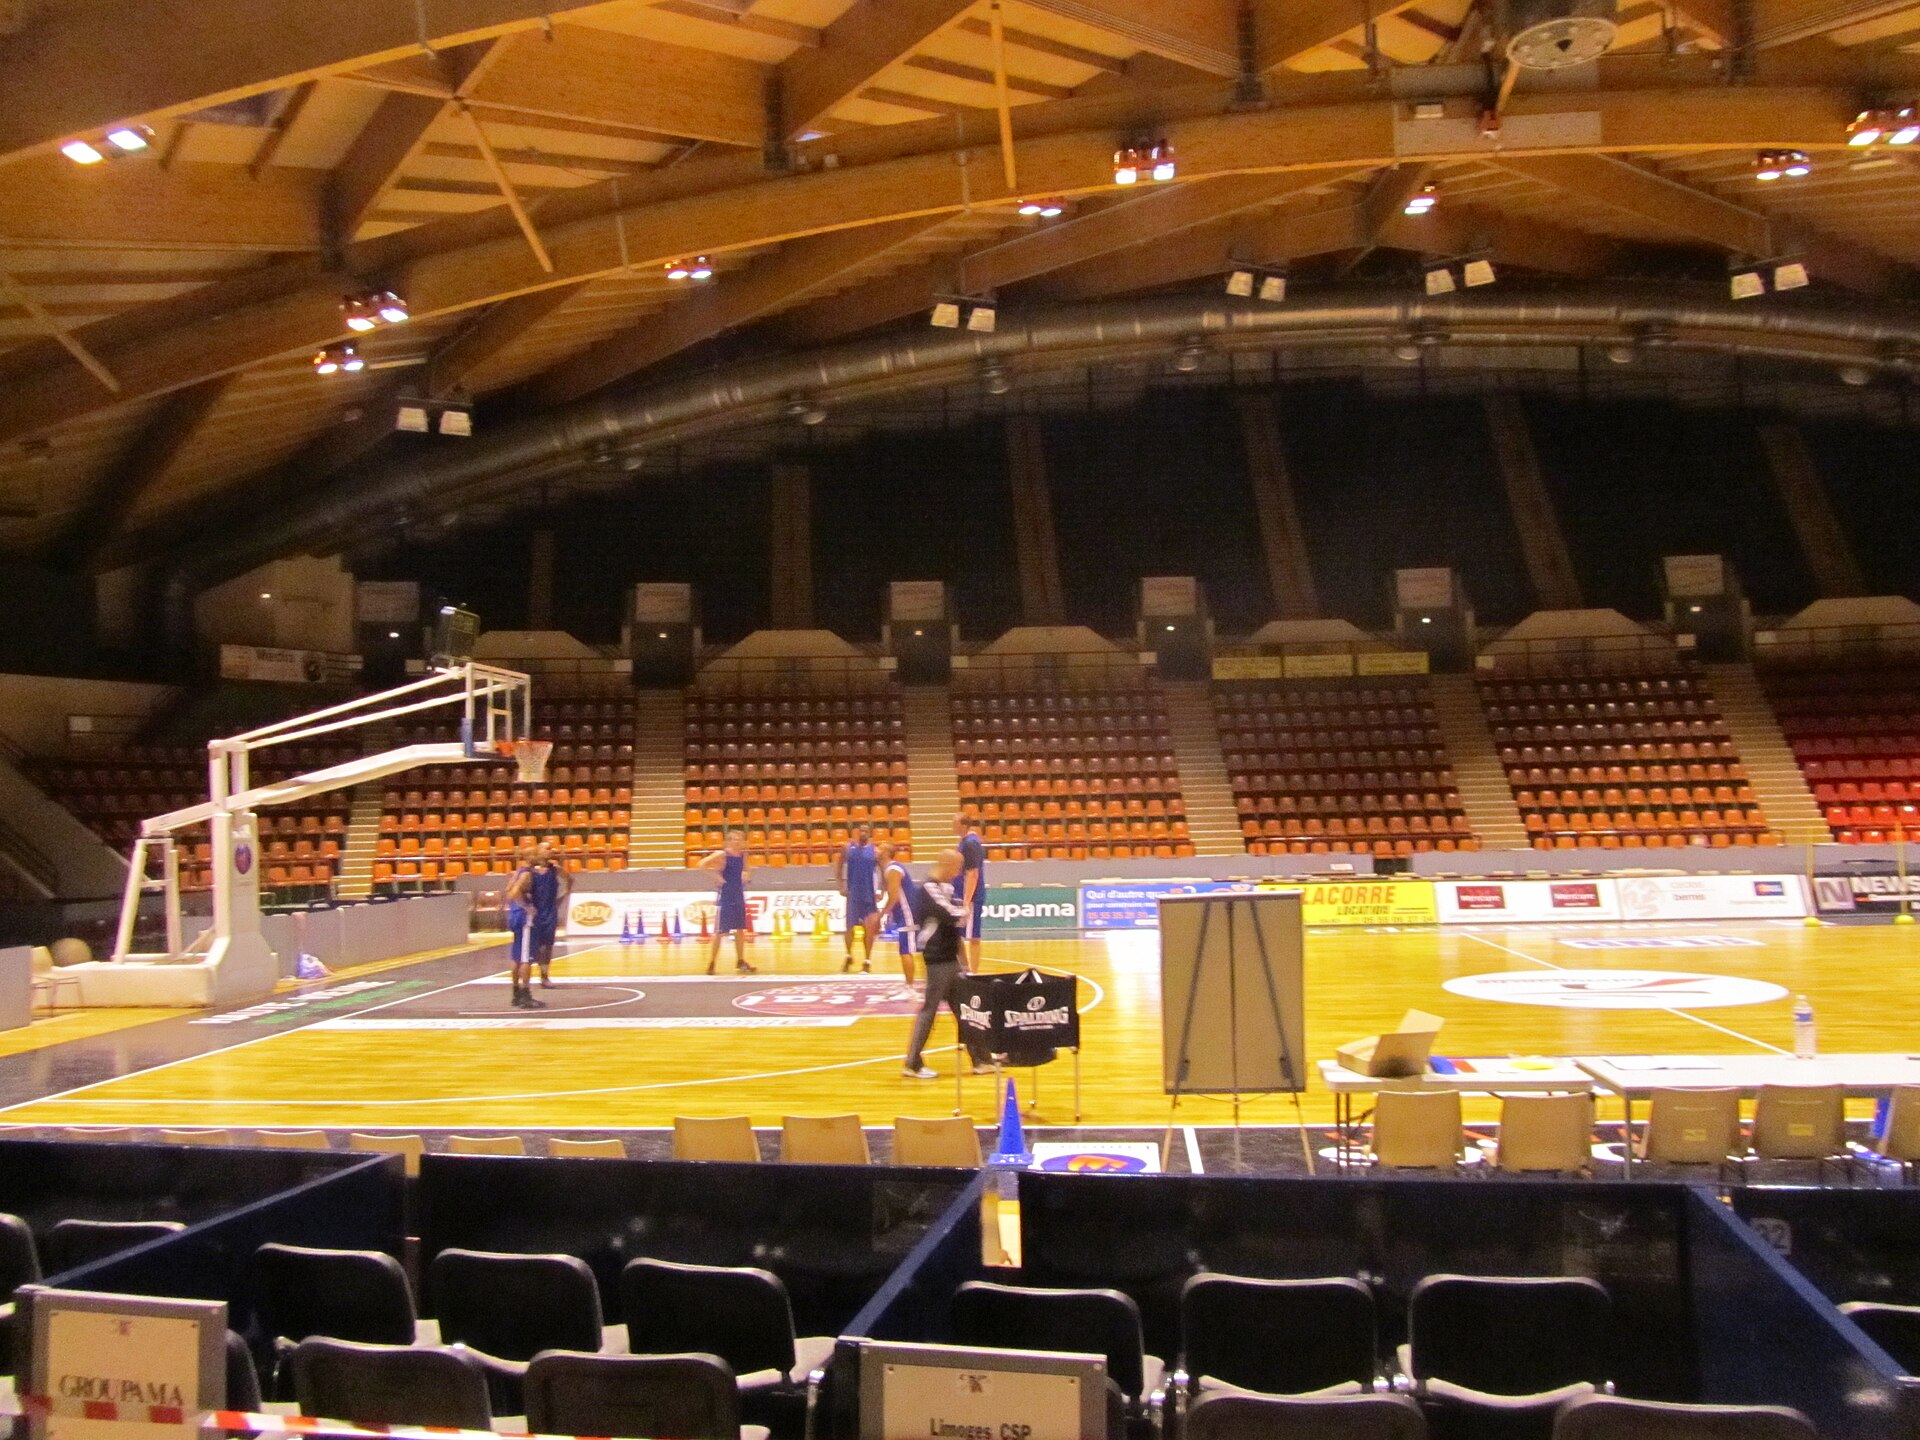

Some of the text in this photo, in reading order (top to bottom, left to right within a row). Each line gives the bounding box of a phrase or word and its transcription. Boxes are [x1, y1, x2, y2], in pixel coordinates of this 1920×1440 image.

[774, 894, 834, 907] EIFFAGE
[1086, 889, 1106, 900] Qui
[1107, 889, 1145, 899] d'autre
[1004, 1006, 1069, 1028] SPALDING
[58, 1375, 183, 1407] GROUPAMA
[929, 1417, 1033, 1440] Limoges CSP
